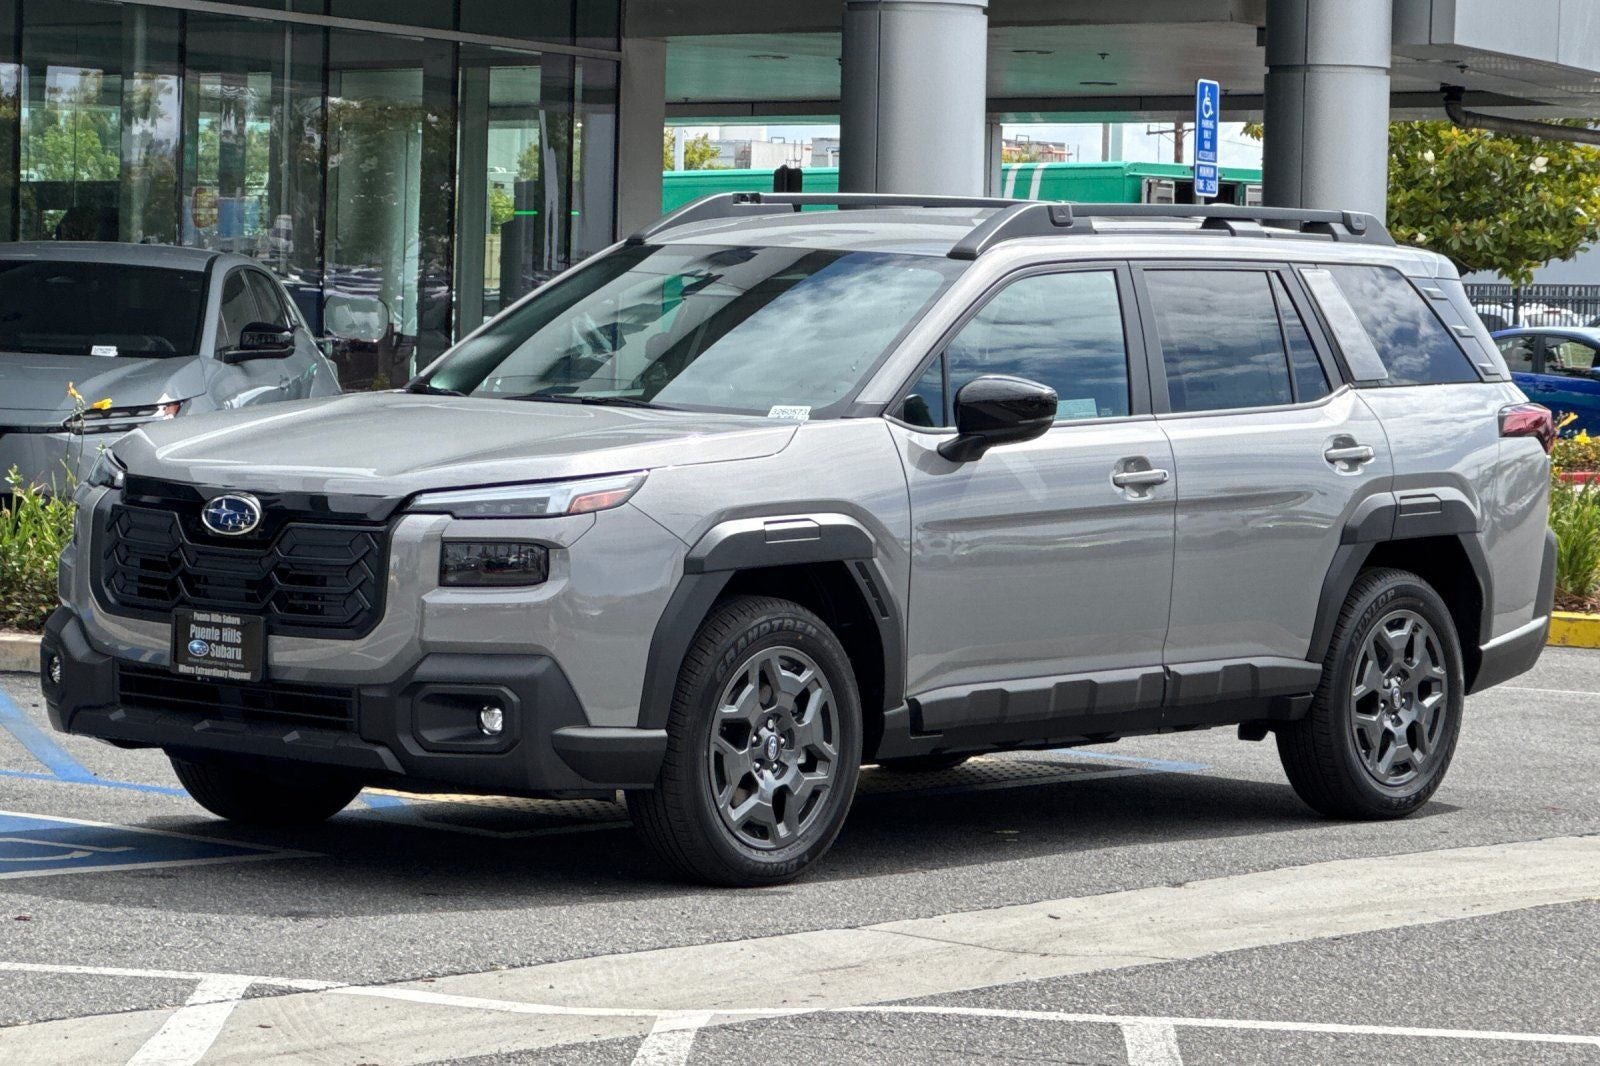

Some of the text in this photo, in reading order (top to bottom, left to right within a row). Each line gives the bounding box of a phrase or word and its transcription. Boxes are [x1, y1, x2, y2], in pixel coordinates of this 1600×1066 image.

[193, 612, 240, 625] Puente Hills Subaru
[189, 624, 242, 644] Puente Hills
[210, 642, 242, 660] Subaru
[178, 664, 194, 673] Where
[195, 665, 228, 678] Extraordinary
